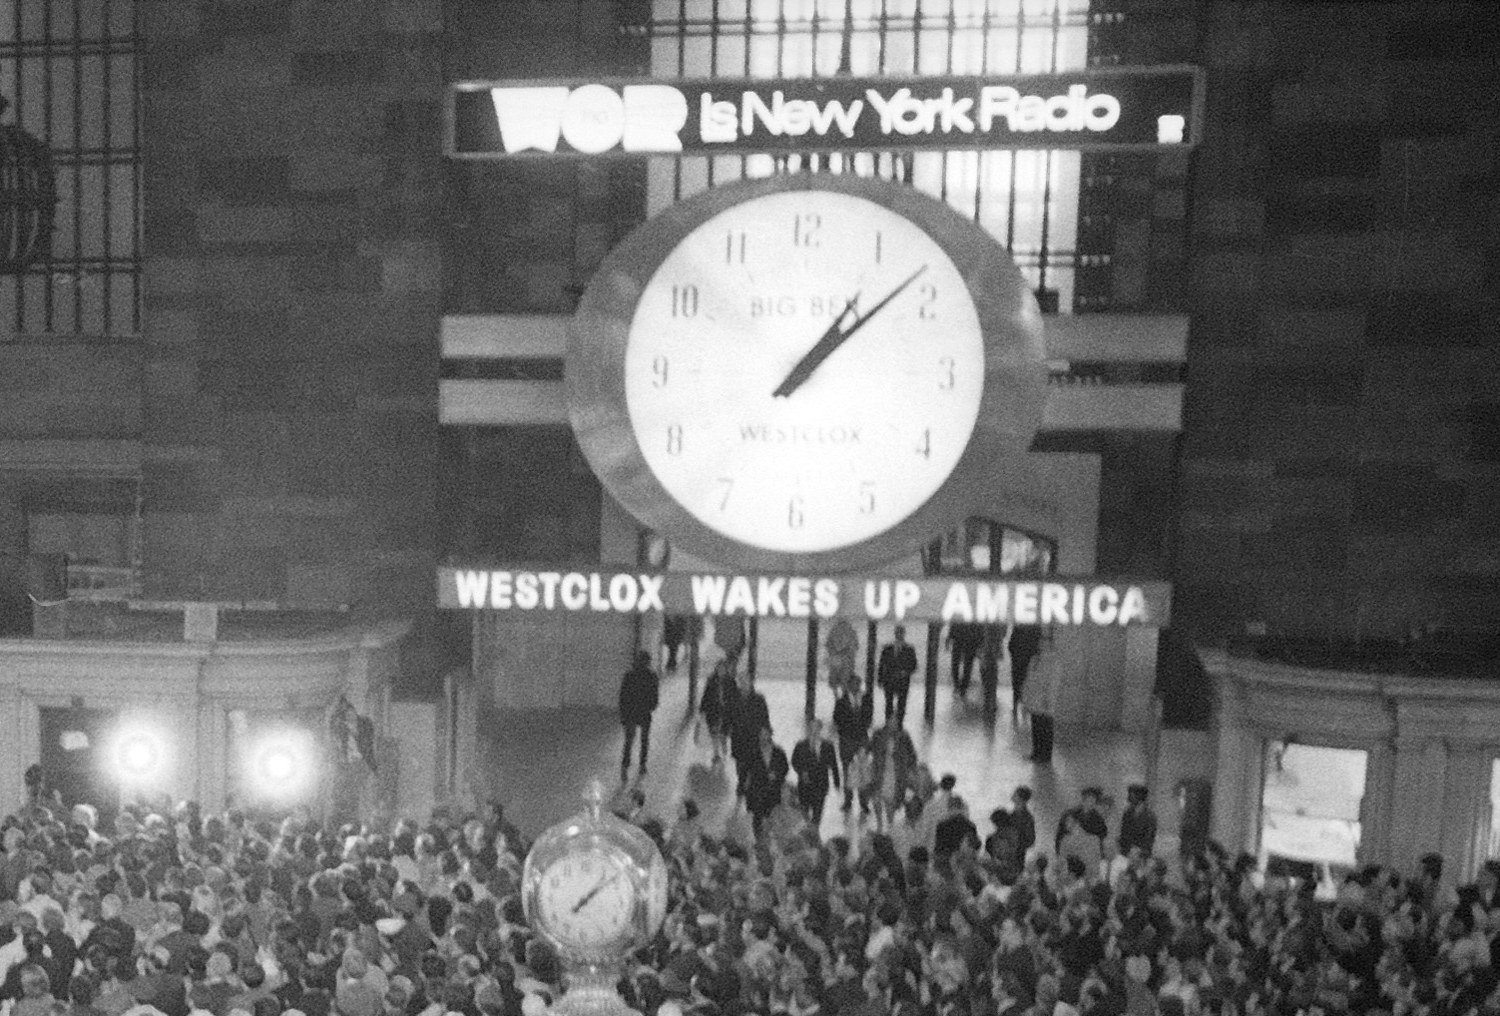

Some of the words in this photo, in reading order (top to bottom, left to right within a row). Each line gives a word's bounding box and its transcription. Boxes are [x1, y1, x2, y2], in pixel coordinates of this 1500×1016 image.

[491, 84, 688, 154] WOR
[742, 90, 864, 138] New
[865, 88, 975, 135] York
[980, 84, 1121, 132] Radio
[672, 284, 698, 318] 10
[751, 296, 796, 318] BIG
[455, 570, 664, 613] WESTCLOX
[691, 575, 840, 618] WAKES
[864, 579, 920, 620] UP
[941, 582, 1149, 626] AMERICA
